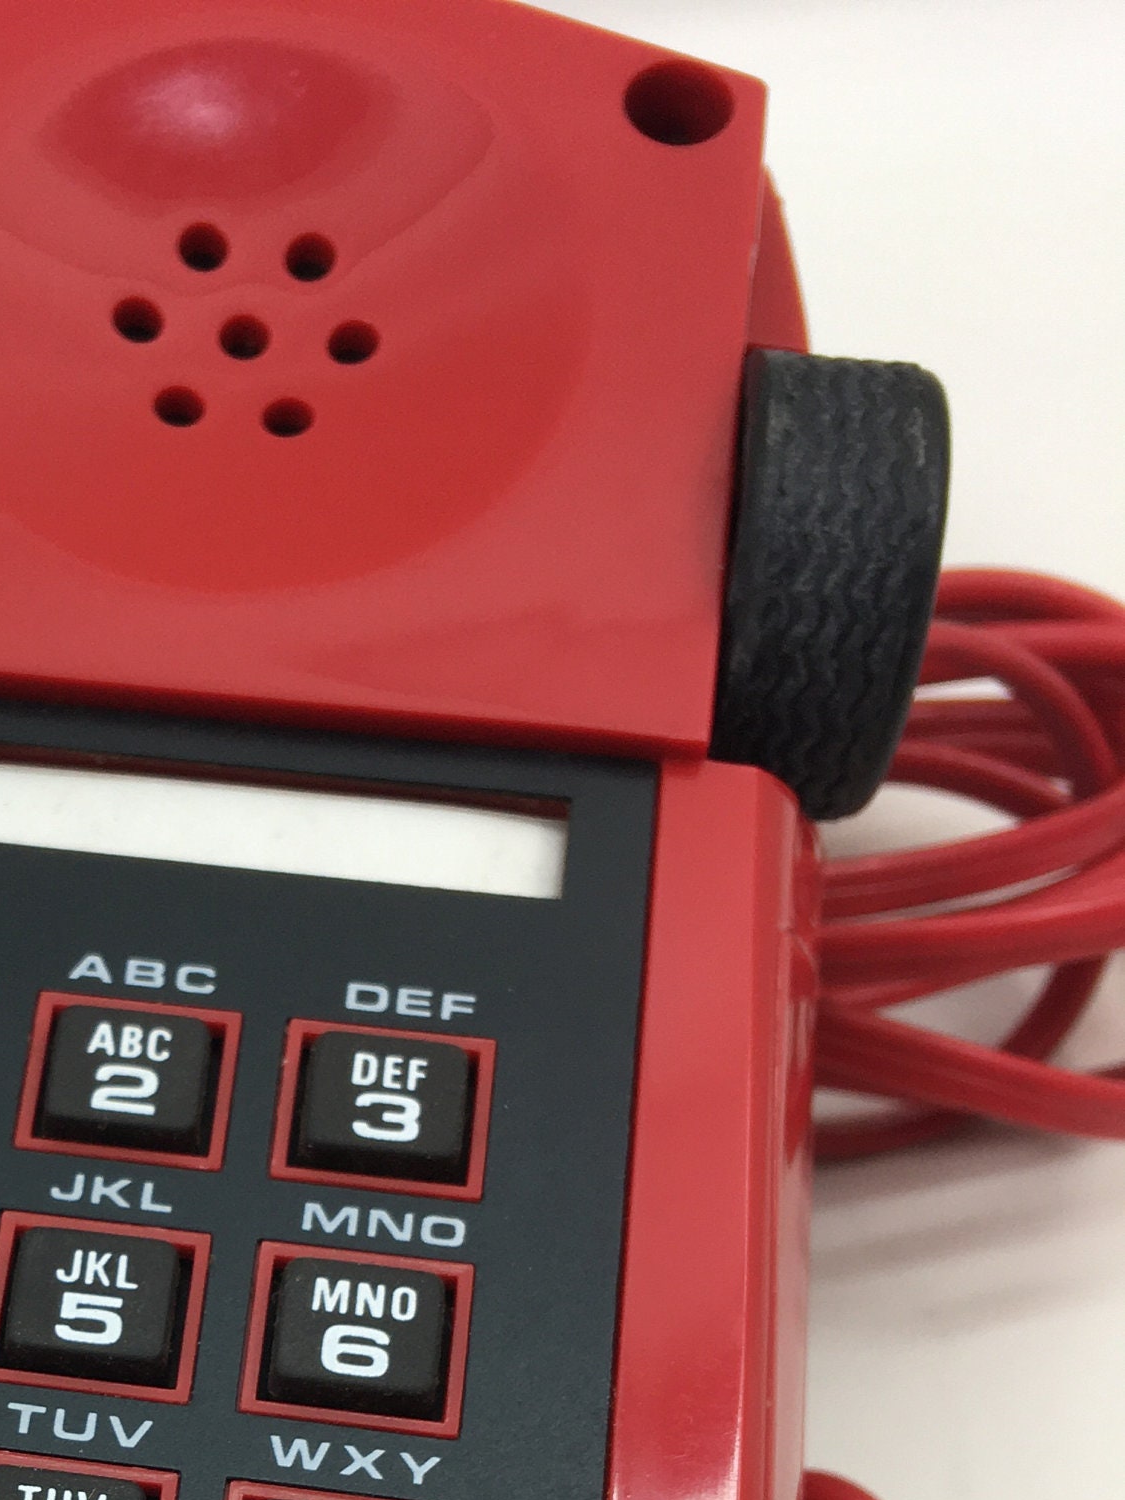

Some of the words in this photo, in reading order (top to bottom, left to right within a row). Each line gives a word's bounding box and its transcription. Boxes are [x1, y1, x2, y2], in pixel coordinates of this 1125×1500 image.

[69, 954, 216, 994] ABC
[345, 982, 476, 1021] DEF
[86, 1021, 173, 1062] ABC
[90, 1063, 159, 1116] 2
[351, 1051, 429, 1092] DEF
[351, 1091, 422, 1142] 3
[50, 1173, 172, 1213] JKL
[301, 1202, 466, 1247] MNO
[55, 1249, 139, 1290] JKL
[54, 1291, 124, 1345] 5
[311, 1276, 418, 1322] MNO
[320, 1324, 391, 1378] 6
[7, 1402, 154, 1448] TUV
[270, 1435, 441, 1485] WXY
